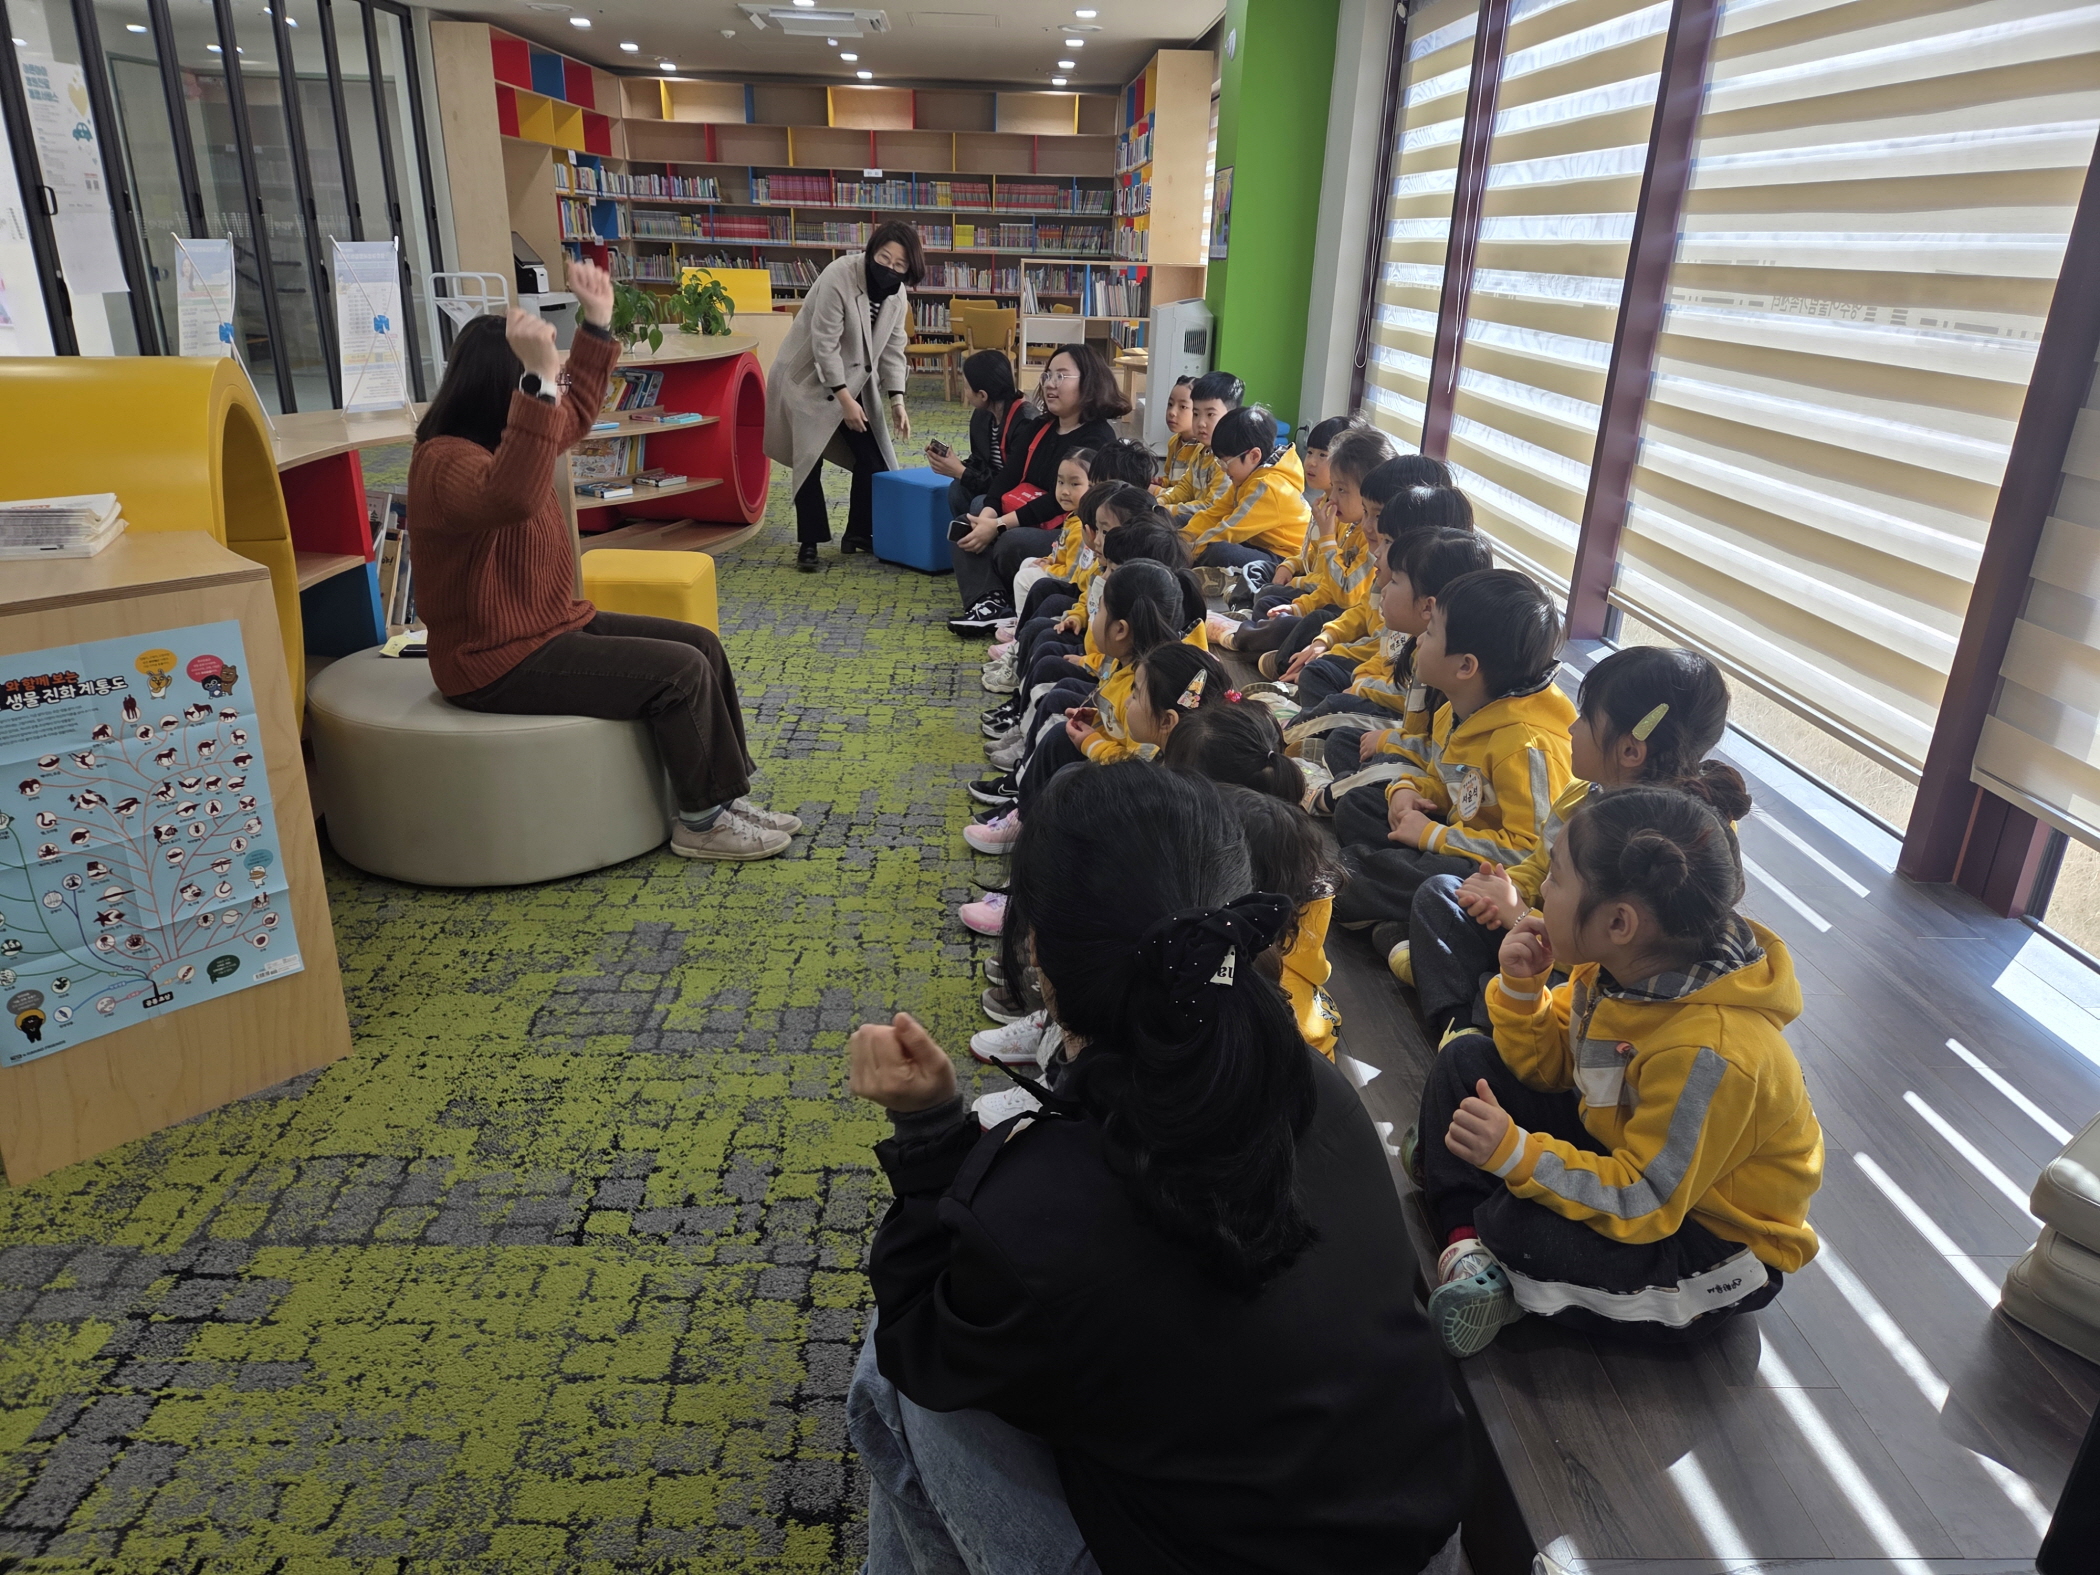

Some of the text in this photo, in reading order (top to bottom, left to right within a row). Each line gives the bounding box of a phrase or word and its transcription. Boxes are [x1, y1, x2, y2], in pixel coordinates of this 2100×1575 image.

[5, 671, 79, 692] 와 함께 보는
[6, 676, 127, 710] 생물 진화 계통도
